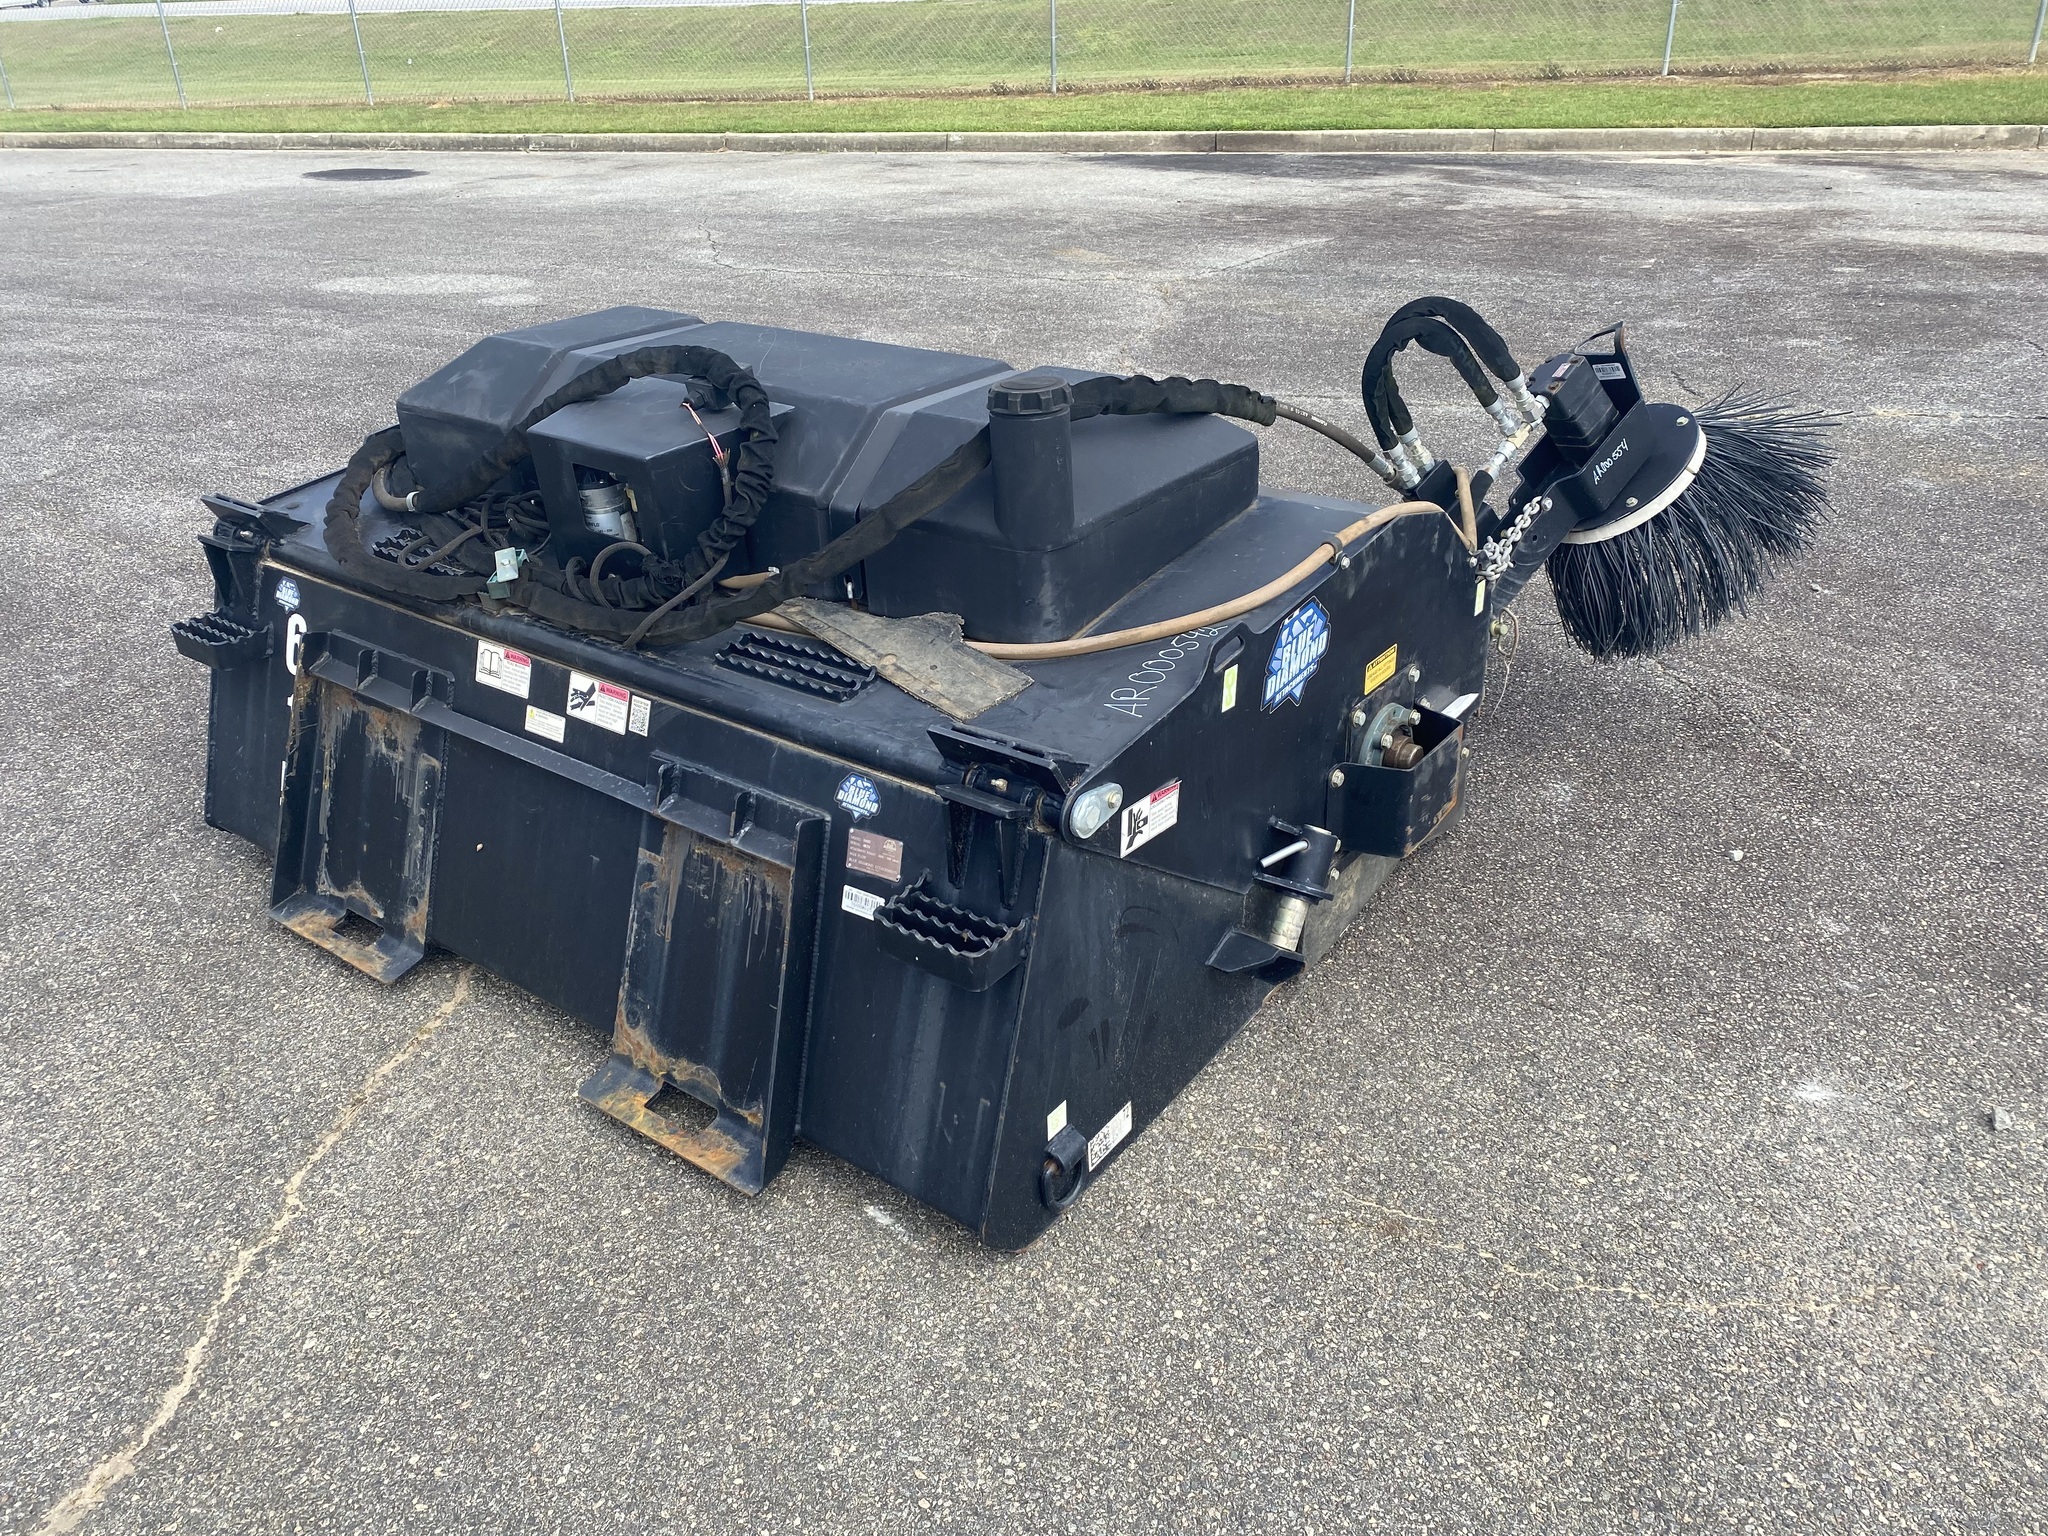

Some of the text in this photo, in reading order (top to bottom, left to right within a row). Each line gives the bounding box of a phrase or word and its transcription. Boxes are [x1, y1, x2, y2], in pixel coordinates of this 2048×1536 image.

[1282, 622, 1315, 673] BLUE
[510, 653, 529, 664] WARNING
[1265, 630, 1329, 701] DIAMOND
[606, 687, 627, 699] WARNING
[836, 789, 879, 813] DIAMOND
[849, 784, 871, 800] BLUE
